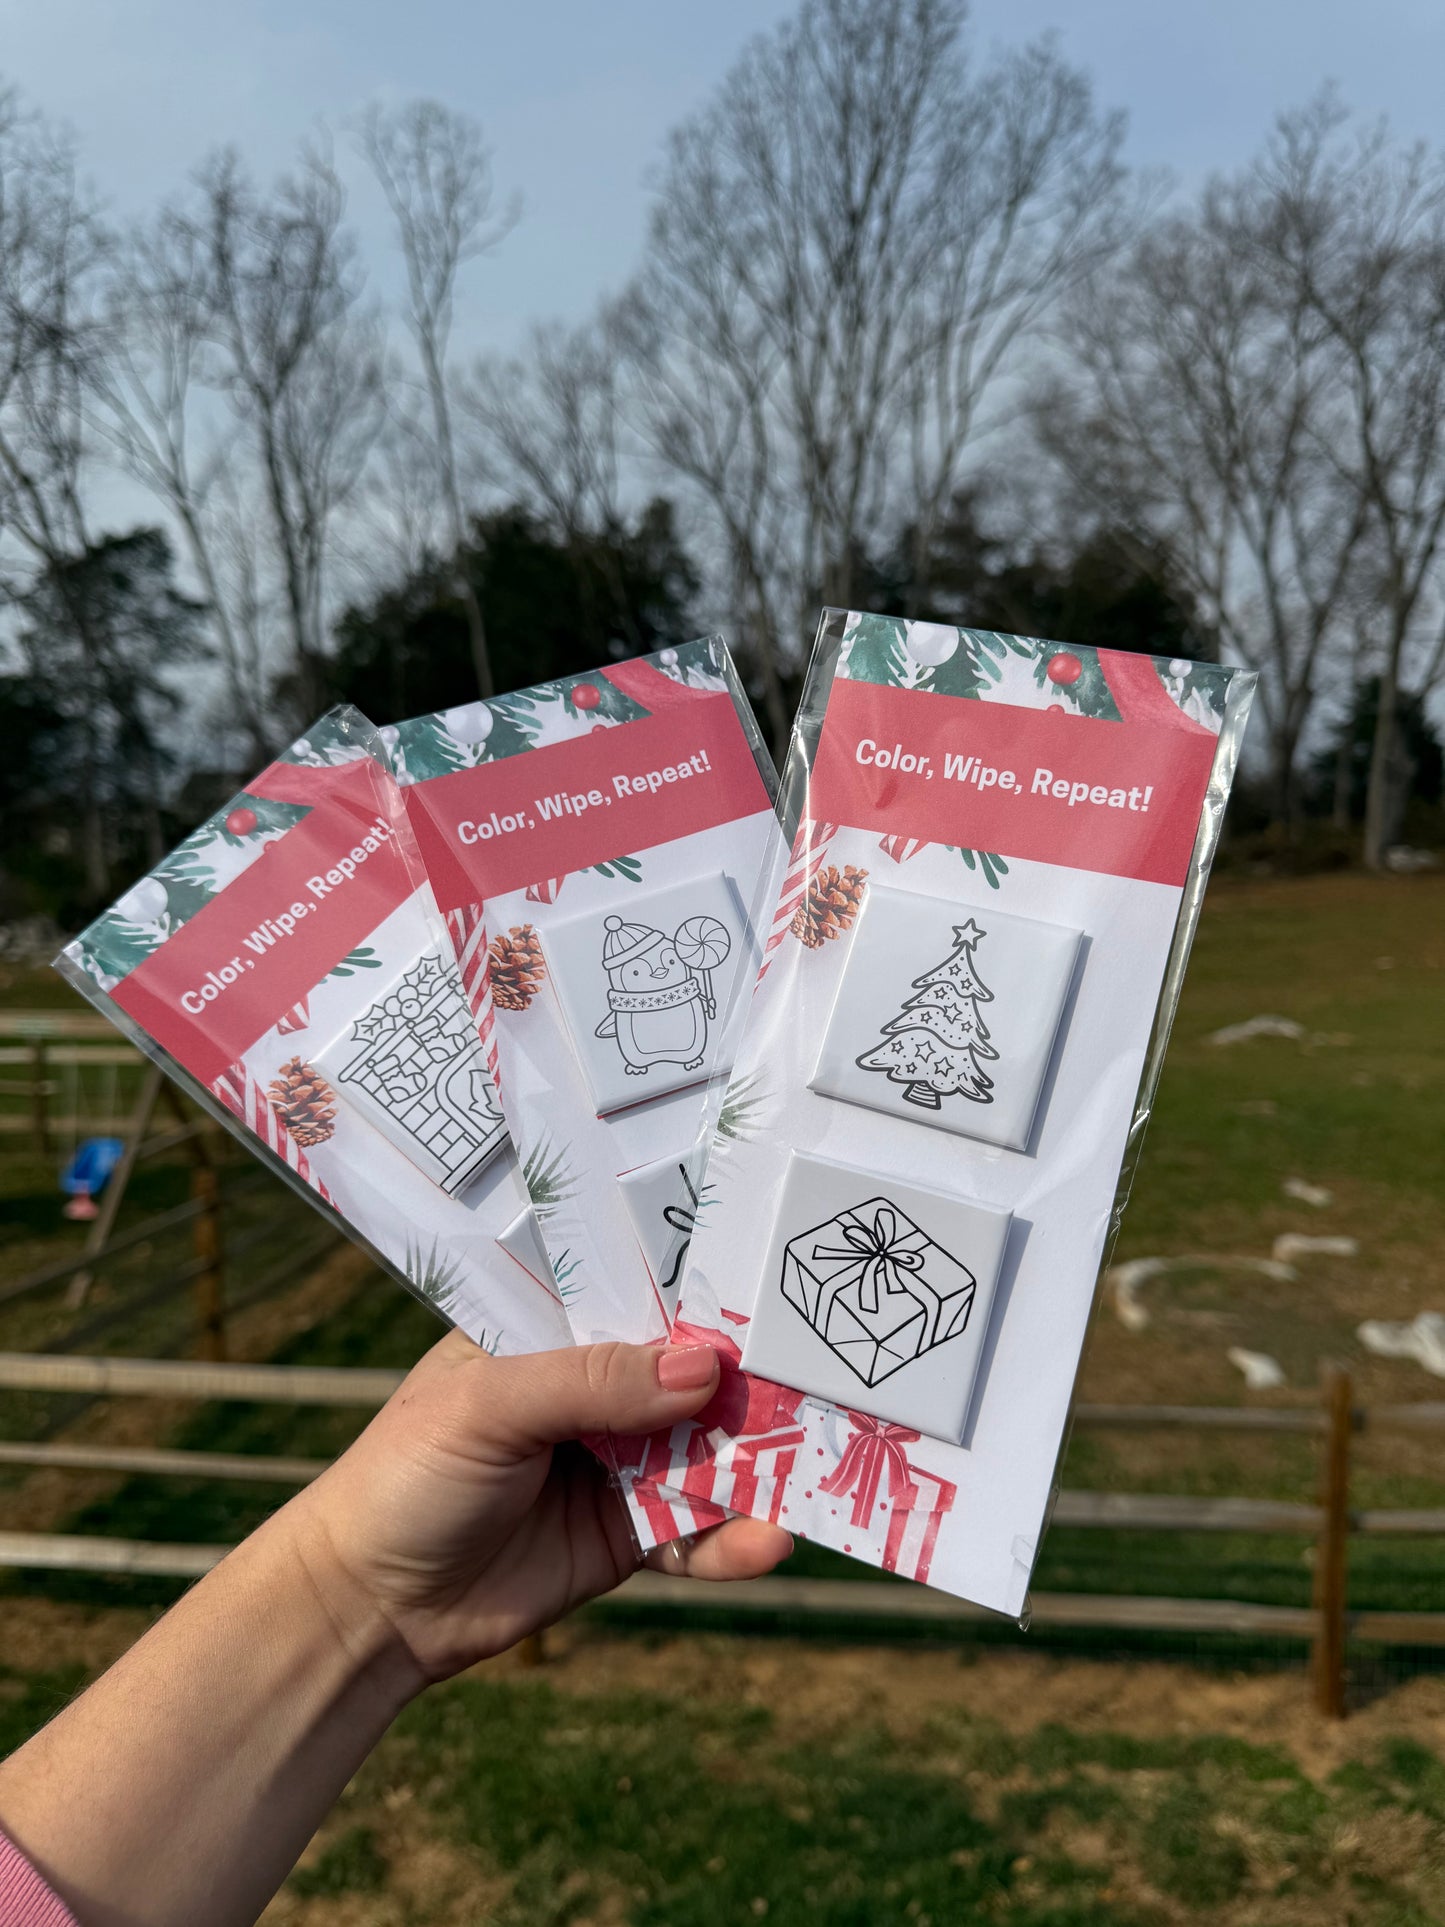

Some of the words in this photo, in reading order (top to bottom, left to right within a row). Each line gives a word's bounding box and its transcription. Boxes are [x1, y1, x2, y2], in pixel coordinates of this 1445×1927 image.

[458, 812, 536, 845] Color,
[535, 788, 612, 821] Wipe,
[612, 750, 713, 798] Repeat!
[855, 739, 934, 779] Color,
[943, 753, 1023, 795] Wipe,
[1030, 768, 1155, 812] Repeat!
[181, 956, 255, 1015] Color,
[242, 901, 317, 955] Wipe,
[304, 817, 396, 900] Repeat!
